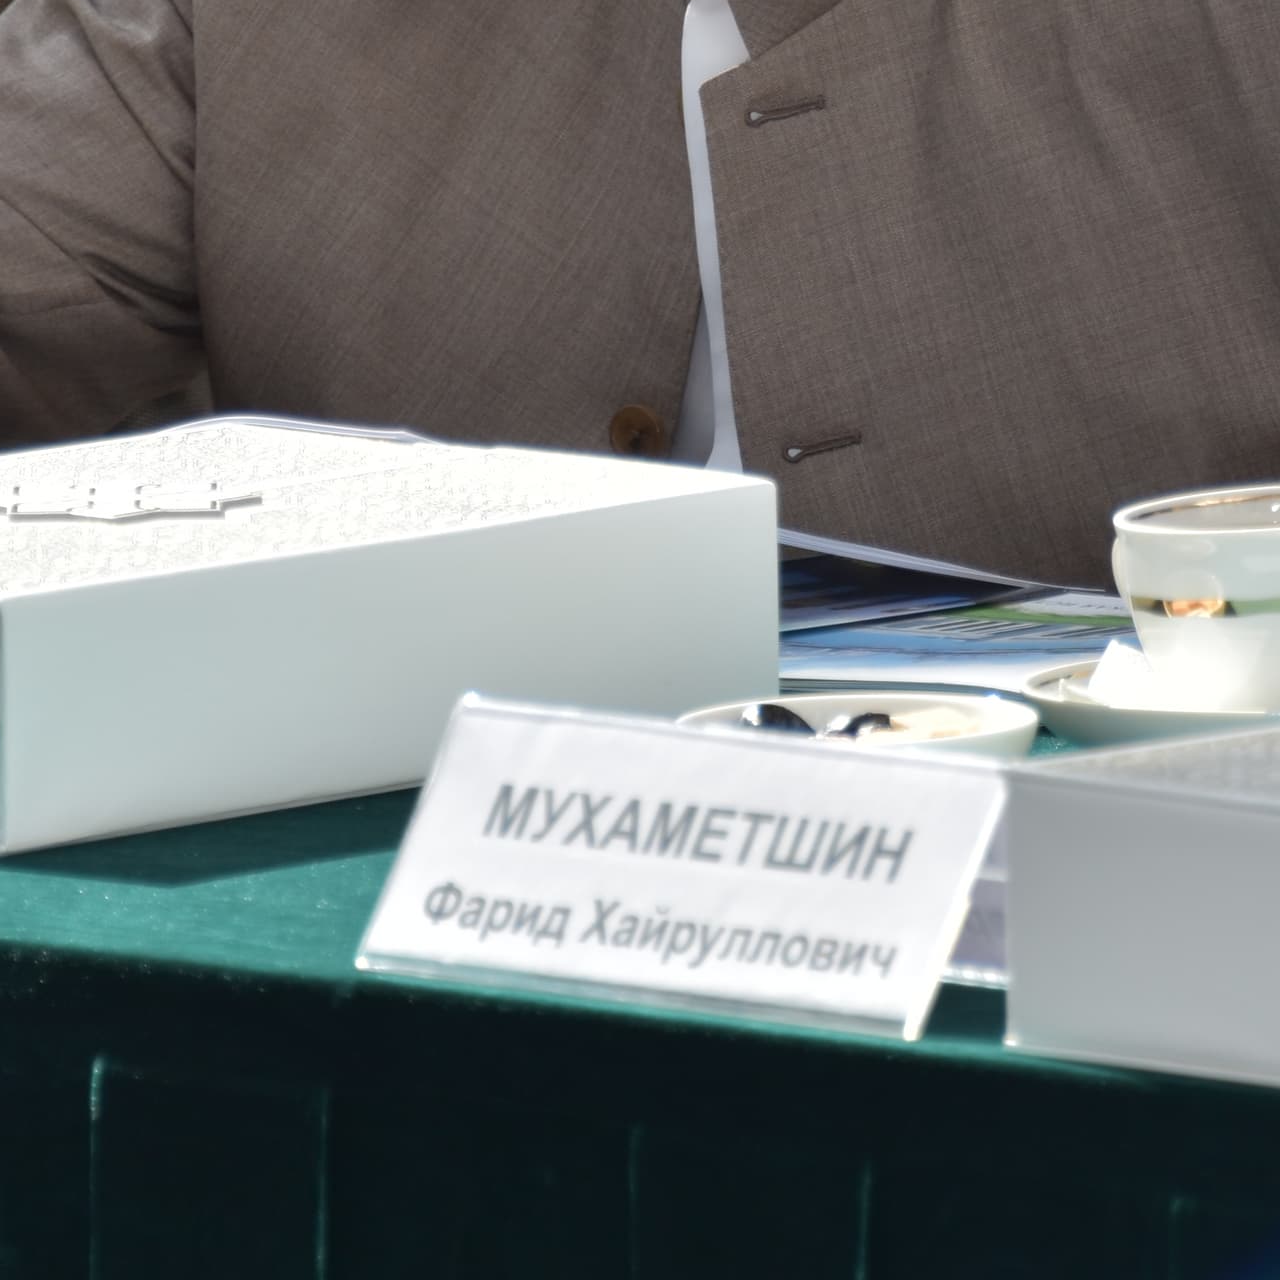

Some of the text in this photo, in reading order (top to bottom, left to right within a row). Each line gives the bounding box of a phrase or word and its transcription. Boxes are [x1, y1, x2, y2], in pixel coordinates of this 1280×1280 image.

[482, 782, 915, 885] МУХАМЕТШИН
[422, 881, 899, 980] Фарид Хайруллович
